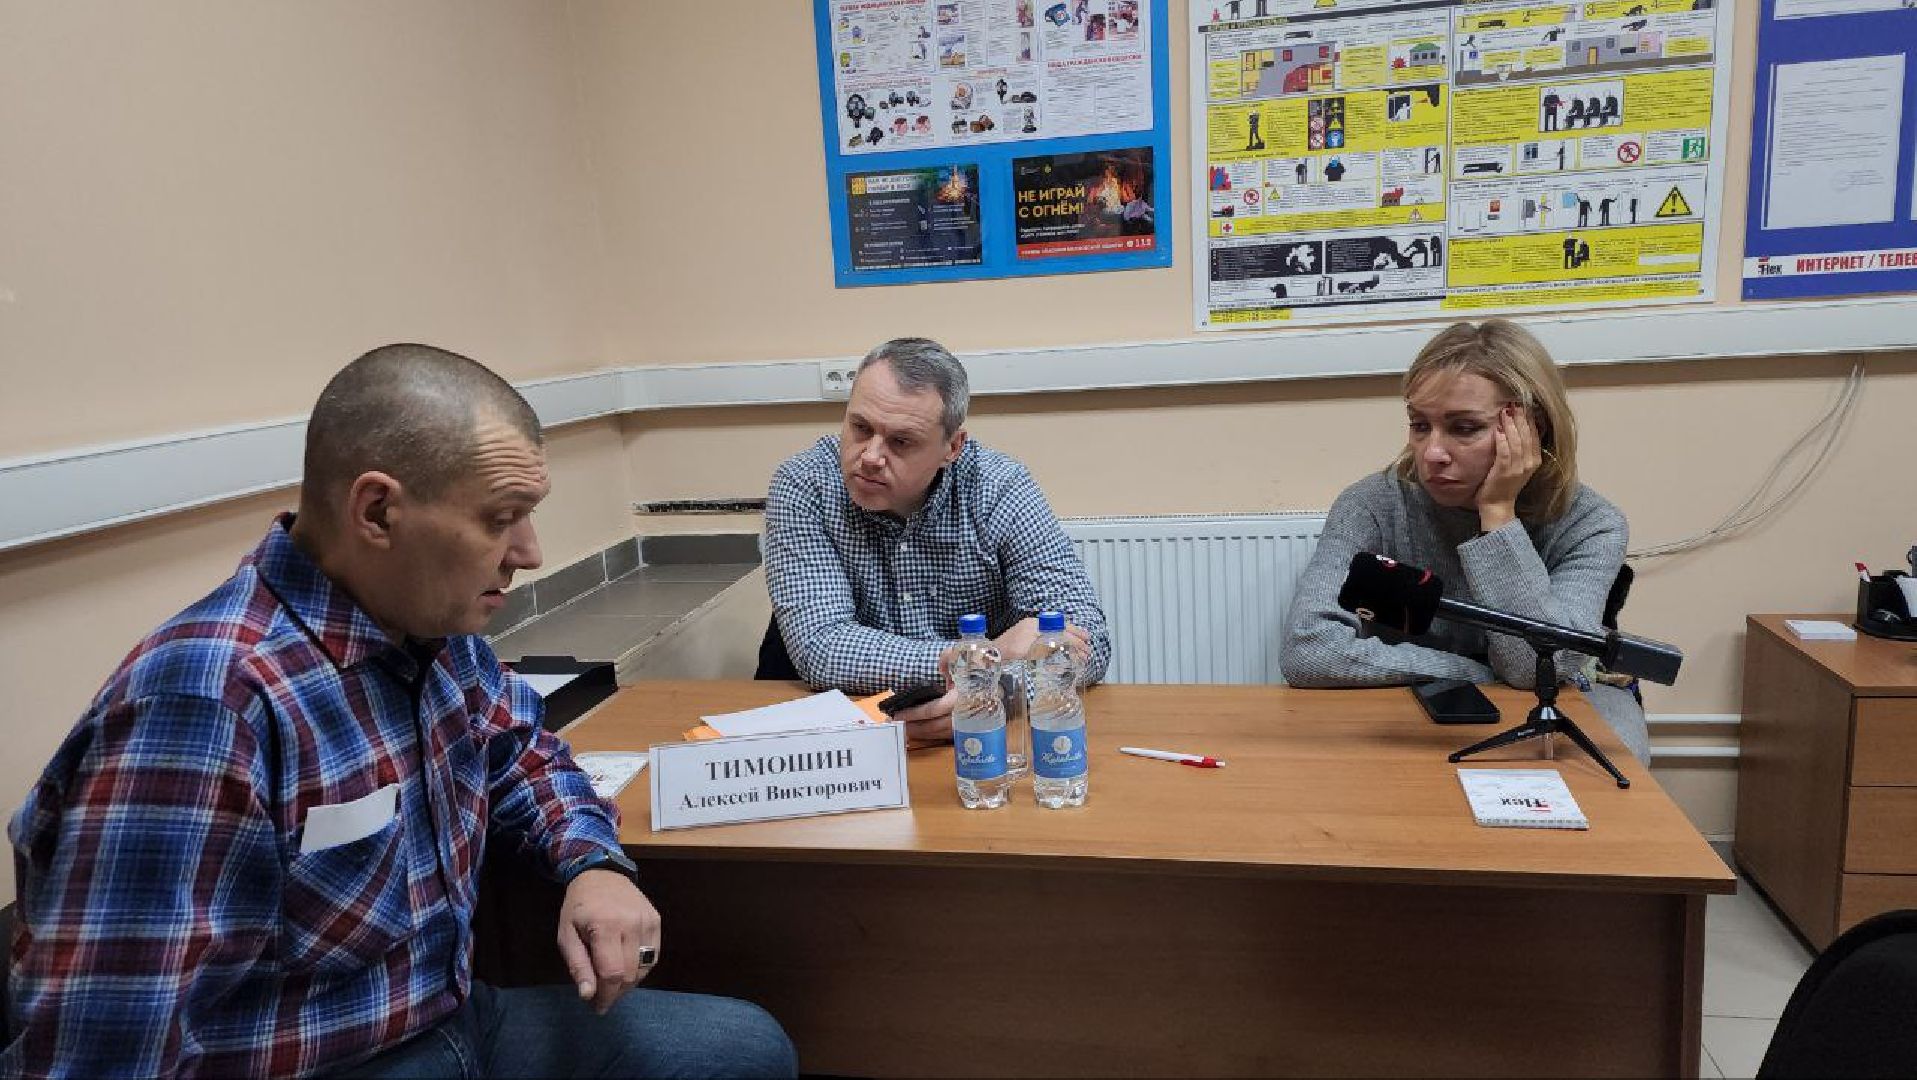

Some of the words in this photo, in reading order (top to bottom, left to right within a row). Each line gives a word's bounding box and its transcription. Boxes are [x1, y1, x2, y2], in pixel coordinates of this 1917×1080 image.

[1018, 190, 1037, 203] НЕ
[1039, 183, 1085, 201] ИГРАЙ
[1018, 207, 1029, 218] С
[1796, 255, 1865, 273] ИНТЕРНЕТ
[705, 748, 853, 781] ТИМОШИН
[681, 787, 759, 811] Алексей
[767, 777, 882, 802] Викторович
